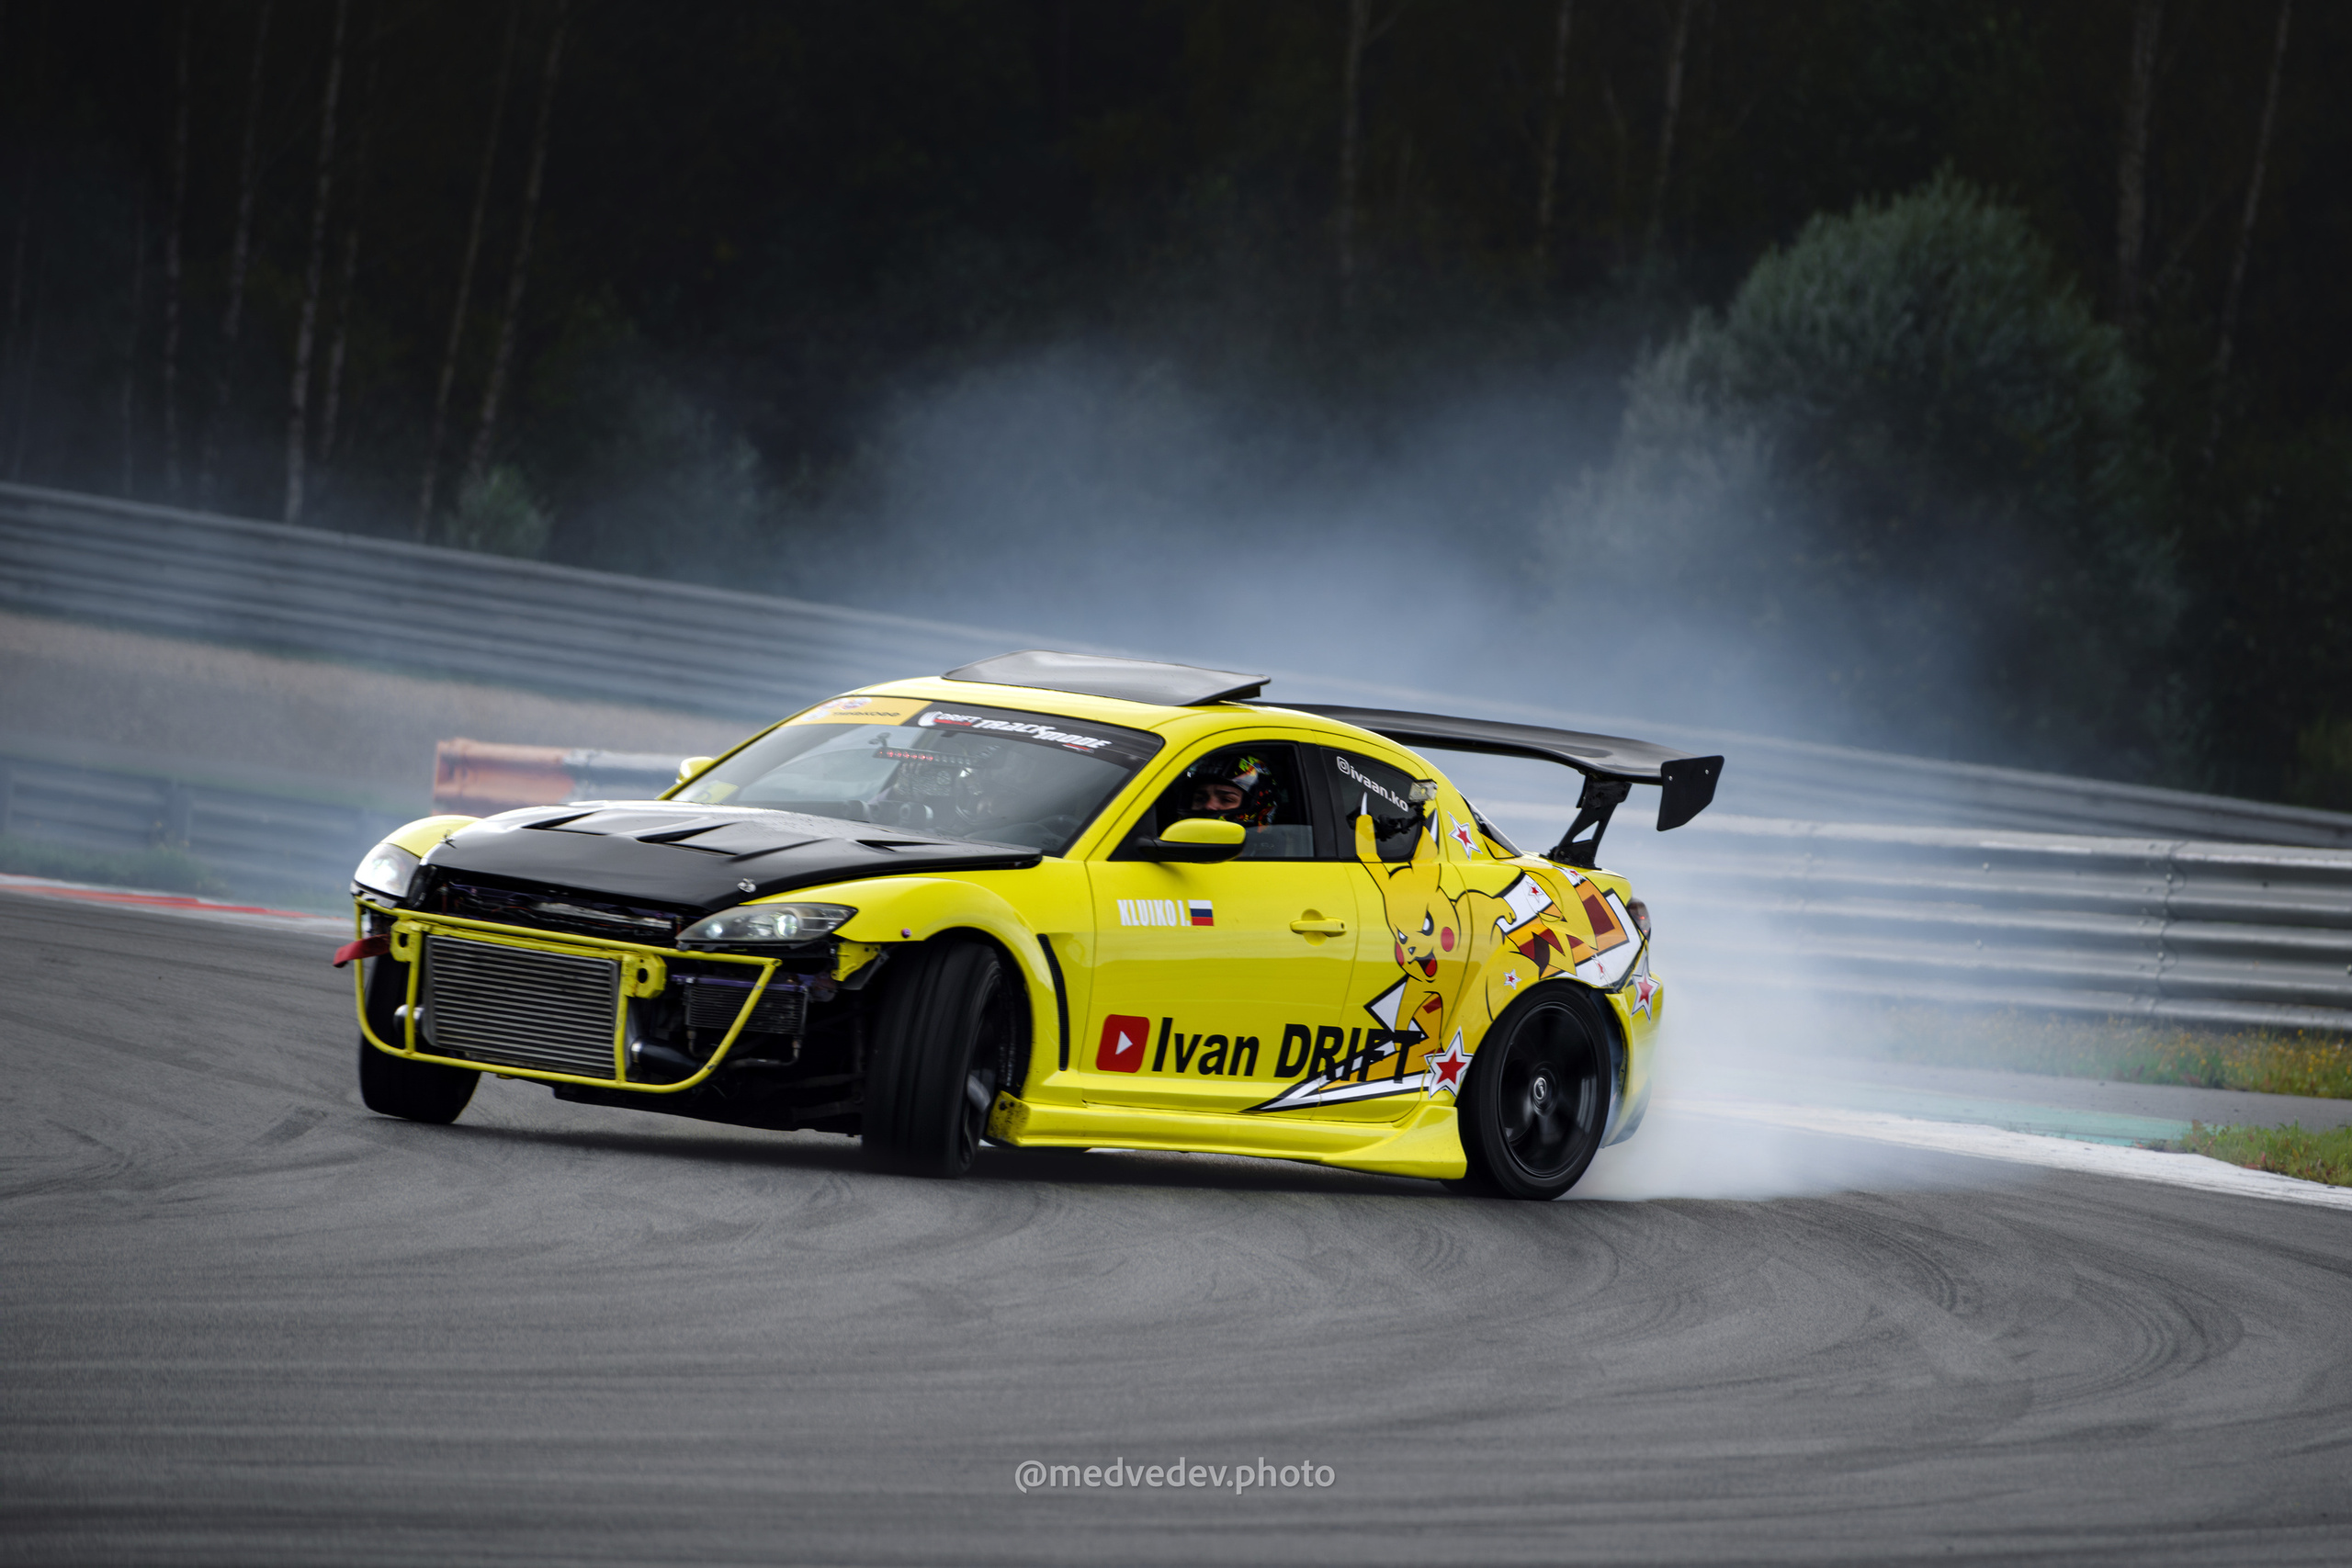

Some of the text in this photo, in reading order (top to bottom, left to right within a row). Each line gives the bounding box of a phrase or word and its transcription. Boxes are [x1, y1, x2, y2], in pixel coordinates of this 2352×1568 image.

[1116, 898, 1177, 927] KLUIKO
[1151, 1017, 1421, 1084] Ivan DRIFT
